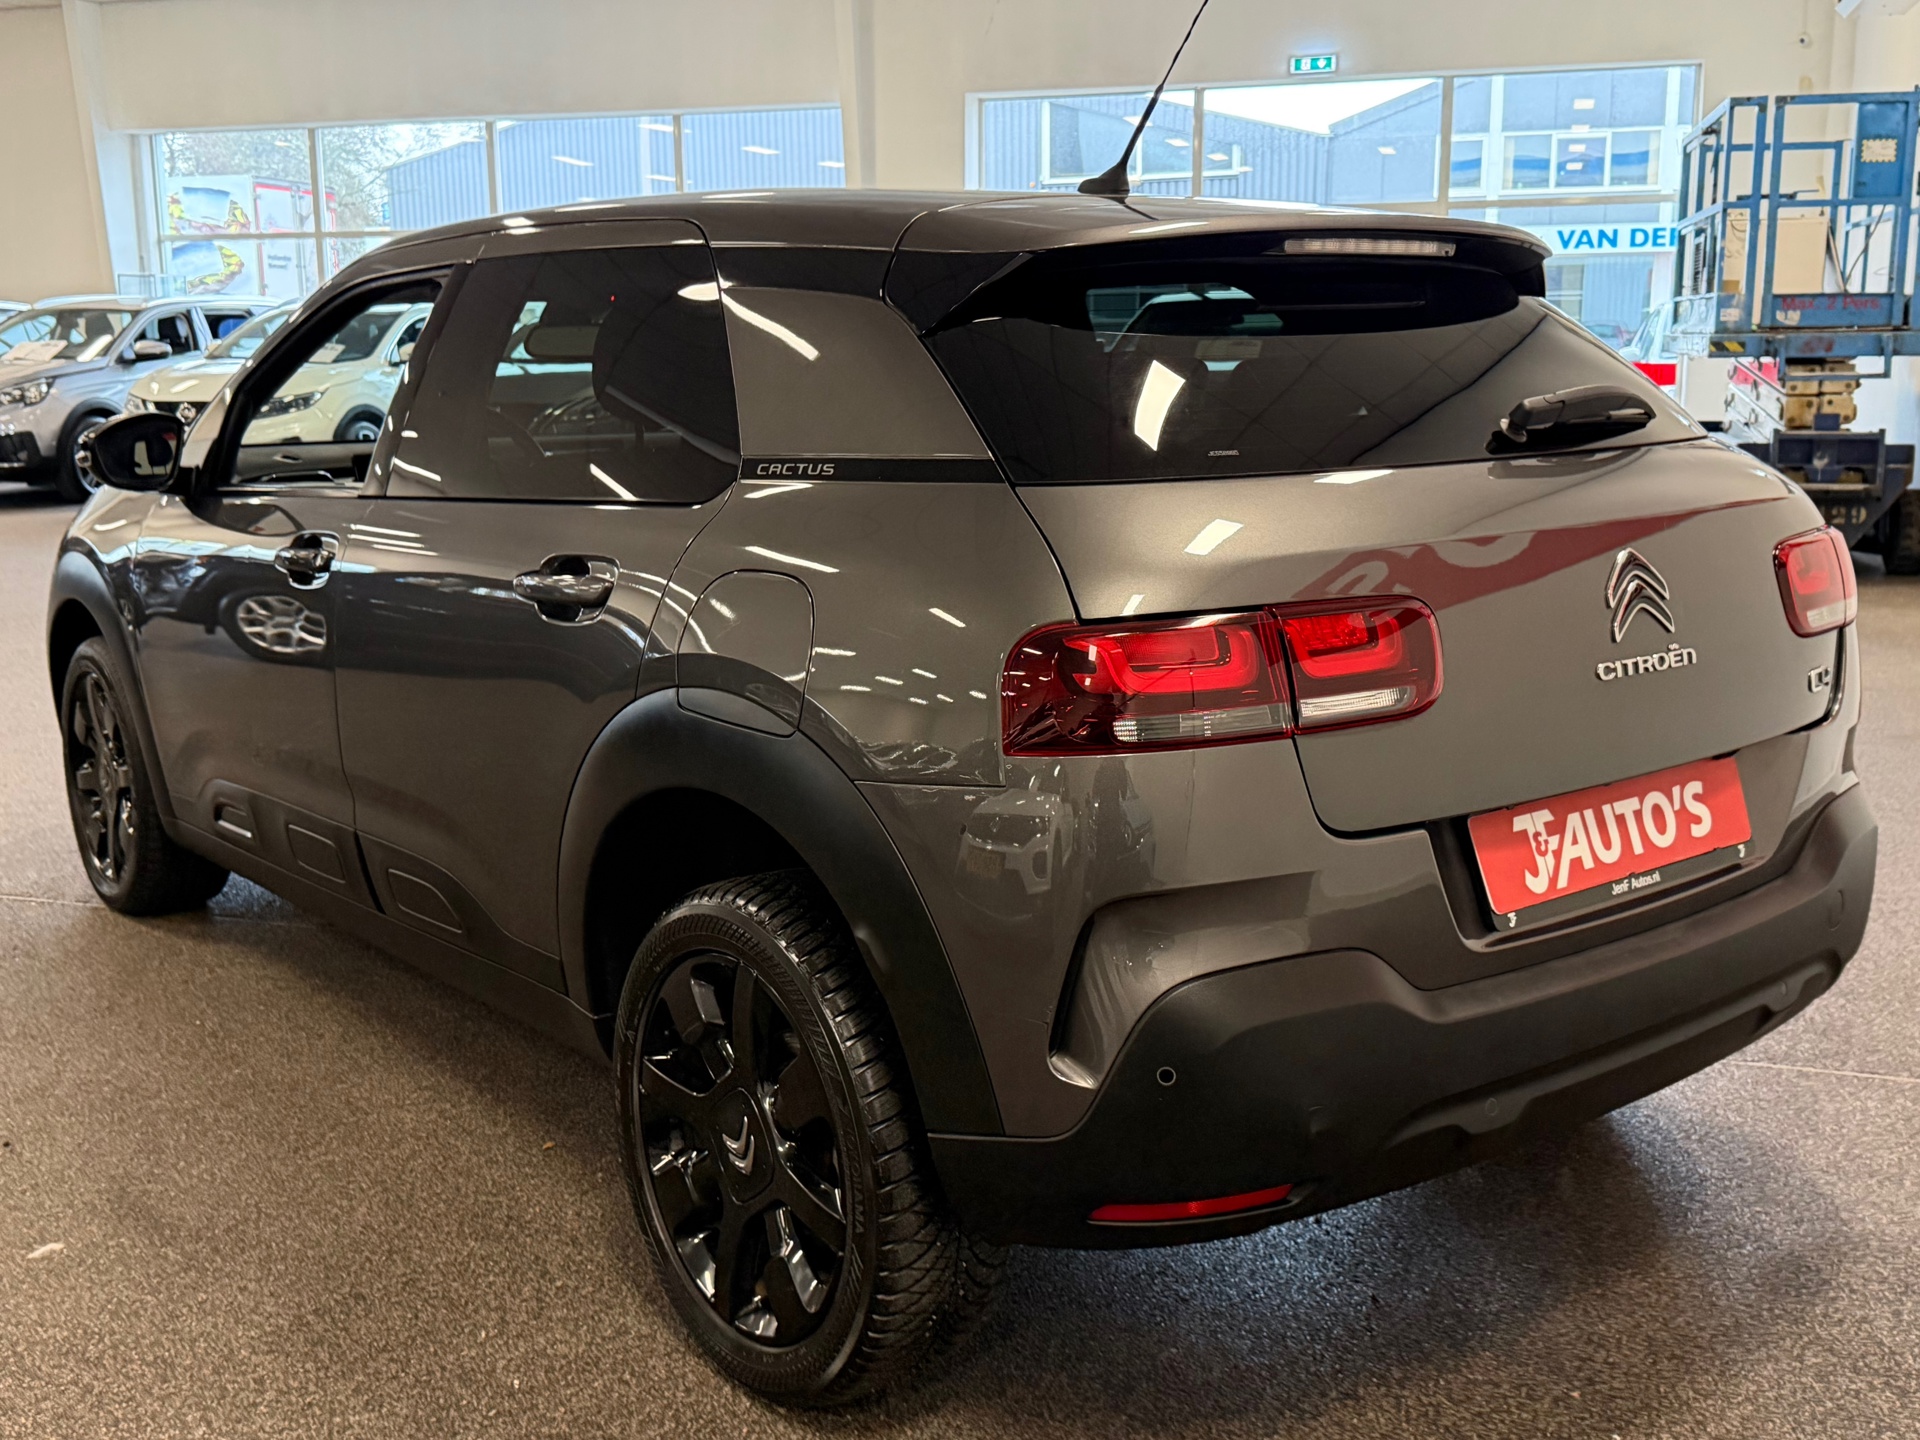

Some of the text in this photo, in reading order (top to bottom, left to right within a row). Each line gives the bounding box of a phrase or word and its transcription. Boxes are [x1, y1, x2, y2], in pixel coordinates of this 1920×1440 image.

[1557, 229, 1619, 249] VAN
[1827, 296, 1837, 310] 2
[756, 463, 835, 475] CACTUS
[1807, 666, 1831, 693] C4
[1556, 780, 1712, 890] AUTO'S
[1611, 870, 1661, 895] JenF Autos.nl
